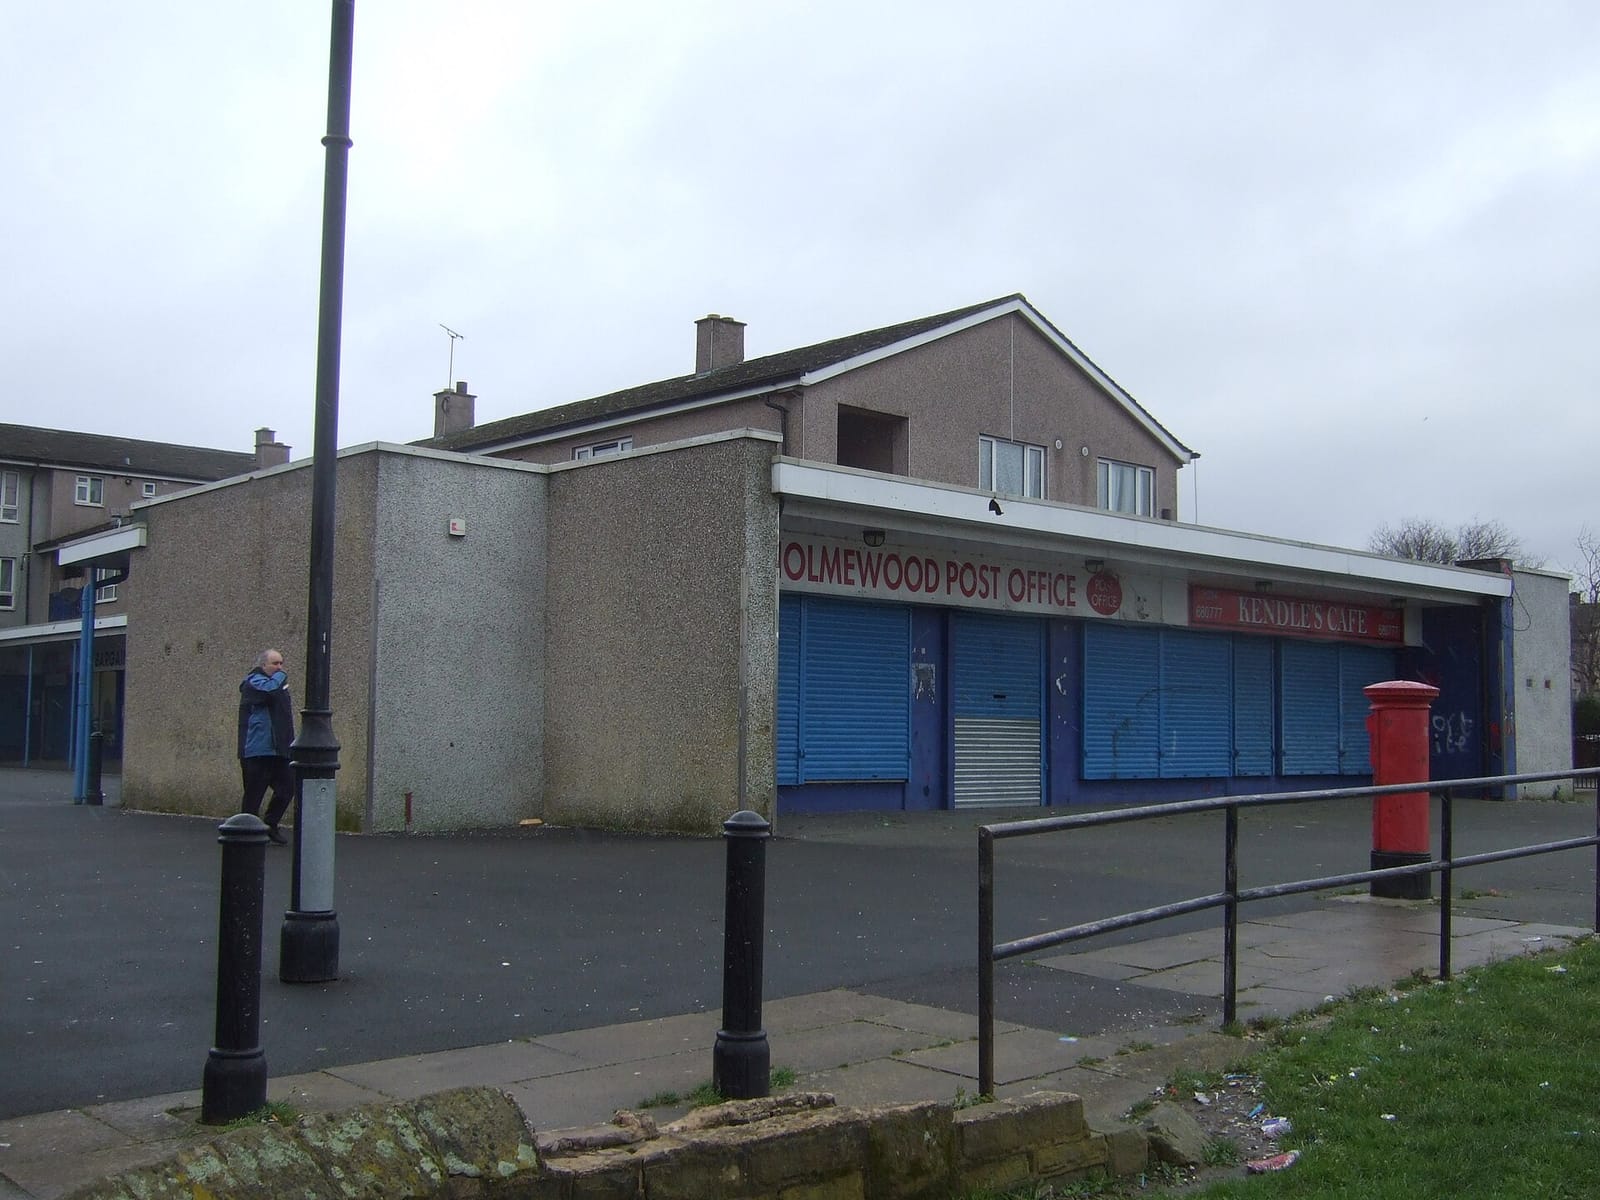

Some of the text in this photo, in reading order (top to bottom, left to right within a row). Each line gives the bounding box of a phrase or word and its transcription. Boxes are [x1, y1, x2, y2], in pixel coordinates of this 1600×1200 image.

[779, 541, 940, 593] OLMEWOOD
[946, 560, 1000, 599] POST
[1239, 596, 1368, 634] KENDLE'S CAFE
